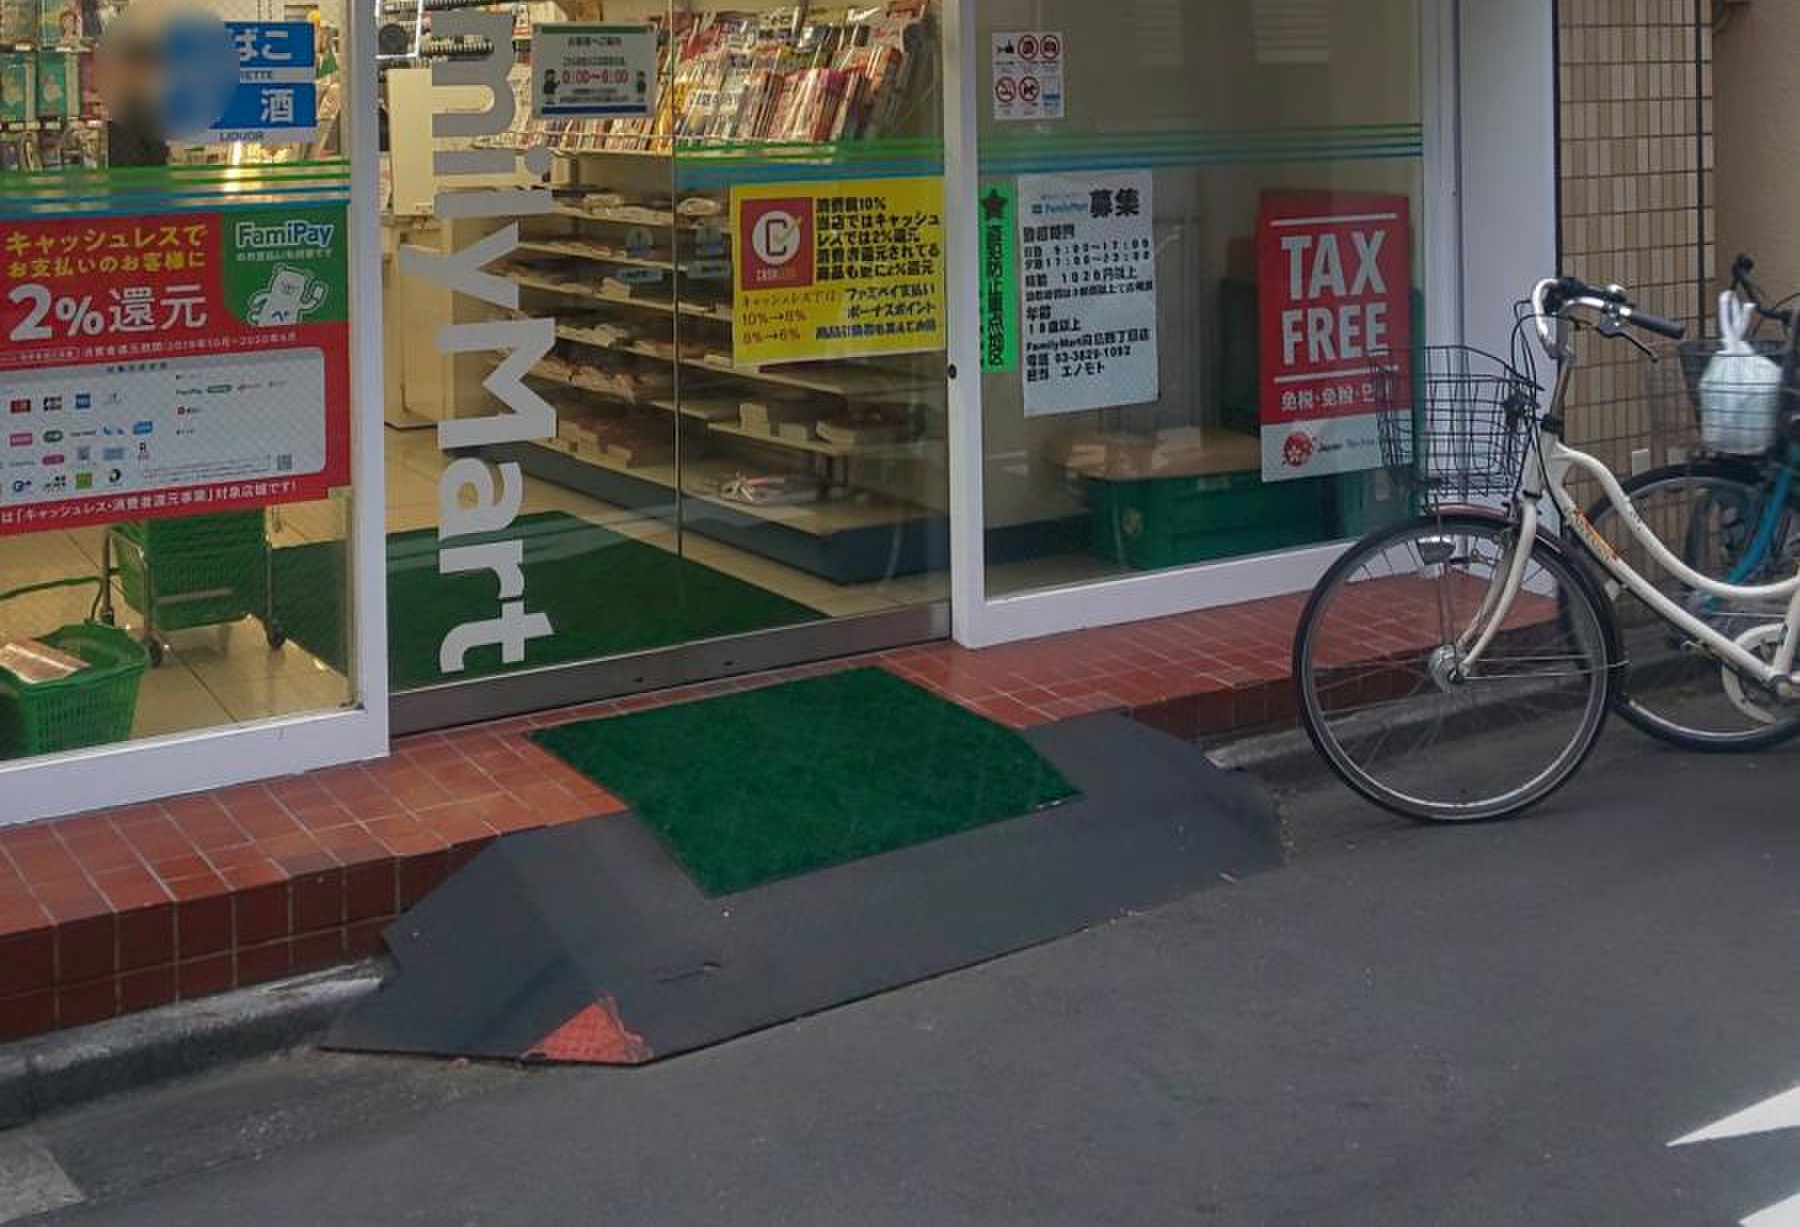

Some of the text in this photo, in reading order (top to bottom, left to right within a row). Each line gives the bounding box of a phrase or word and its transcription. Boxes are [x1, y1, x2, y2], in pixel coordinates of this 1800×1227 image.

[260, 87, 295, 124] 酒
[219, 131, 264, 142] LIQUOR
[1089, 187, 1140, 219] 募集
[5, 223, 208, 256] キャッシュレスで
[235, 219, 335, 247] FamiPay
[9, 250, 207, 279] お支払いのお客様に
[1281, 230, 1387, 301] TAX
[1281, 303, 1389, 366] FREE
